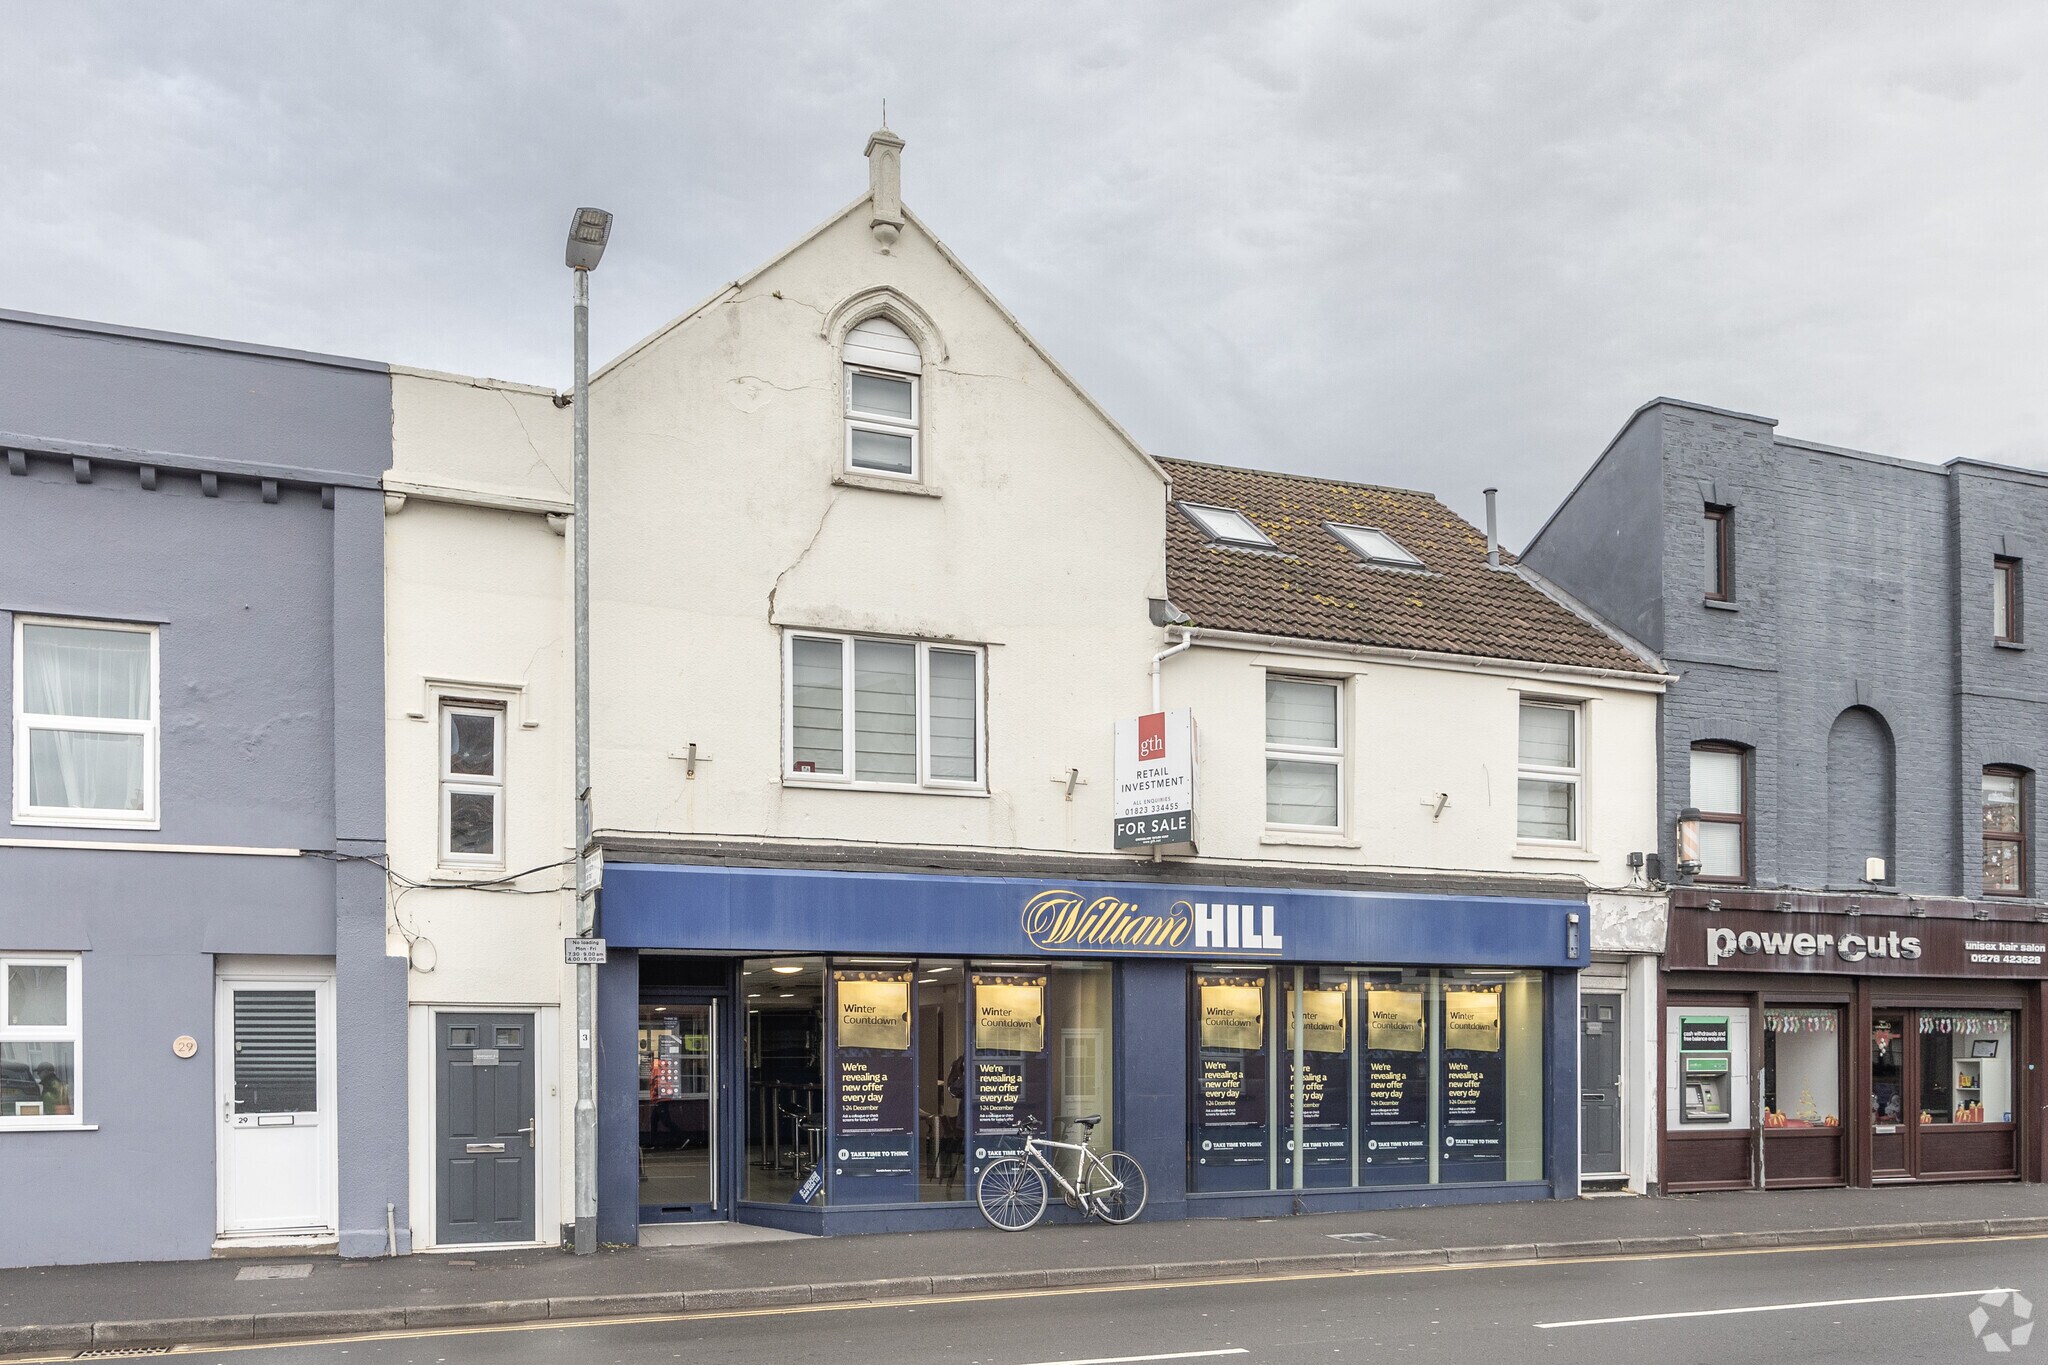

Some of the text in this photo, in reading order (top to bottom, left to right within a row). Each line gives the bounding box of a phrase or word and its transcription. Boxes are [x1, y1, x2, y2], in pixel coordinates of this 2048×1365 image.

[1140, 735, 1163, 757] gth
[1136, 767, 1169, 780] RETAIL
[1121, 776, 1184, 793] INVESTMENT
[1143, 796, 1171, 805] ENQUIRIES
[1125, 802, 1179, 815] 01823 334455
[1117, 816, 1187, 836] FOR SALE
[1021, 889, 1283, 951] William HILL
[1706, 927, 1834, 966] power
[1965, 941, 2046, 952] unisex hair salon
[1971, 954, 2041, 964] 01278 423628
[844, 1004, 876, 1013] Winter
[981, 1007, 1012, 1016] Winter
[1206, 1007, 1235, 1016] Winter
[843, 1015, 897, 1025] Countdown
[1372, 1011, 1398, 1020] Winter
[1450, 1011, 1474, 1020] Winter
[981, 1018, 1032, 1028] Countdown
[1205, 1017, 1251, 1026] Countdown
[1372, 1021, 1414, 1030] Countdown
[1450, 1021, 1490, 1030] Countdown
[178, 1042, 194, 1052] 29
[842, 1063, 867, 1071] We're
[979, 1064, 1003, 1072] We're
[1204, 1061, 1227, 1069] We're
[1370, 1063, 1391, 1071] We're
[842, 1073, 881, 1083] revealing
[980, 1073, 1016, 1083] revealing
[1204, 1071, 1238, 1080] revealing
[1370, 1072, 1401, 1081] revealing
[1448, 1071, 1478, 1080] revealing
[862, 1082, 884, 1091] offer
[998, 1083, 1019, 1092] offer
[1222, 1080, 1240, 1088] offer
[1306, 1082, 1324, 1090] offer
[1386, 1081, 1403, 1089] offer
[1463, 1080, 1480, 1088] offer
[842, 1093, 884, 1103] every day
[1205, 1089, 1240, 1098] every day
[1310, 1092, 1324, 1101] day
[1390, 1090, 1403, 1099] day
[1448, 1089, 1480, 1098] every day
[980, 1094, 1019, 1103] every day
